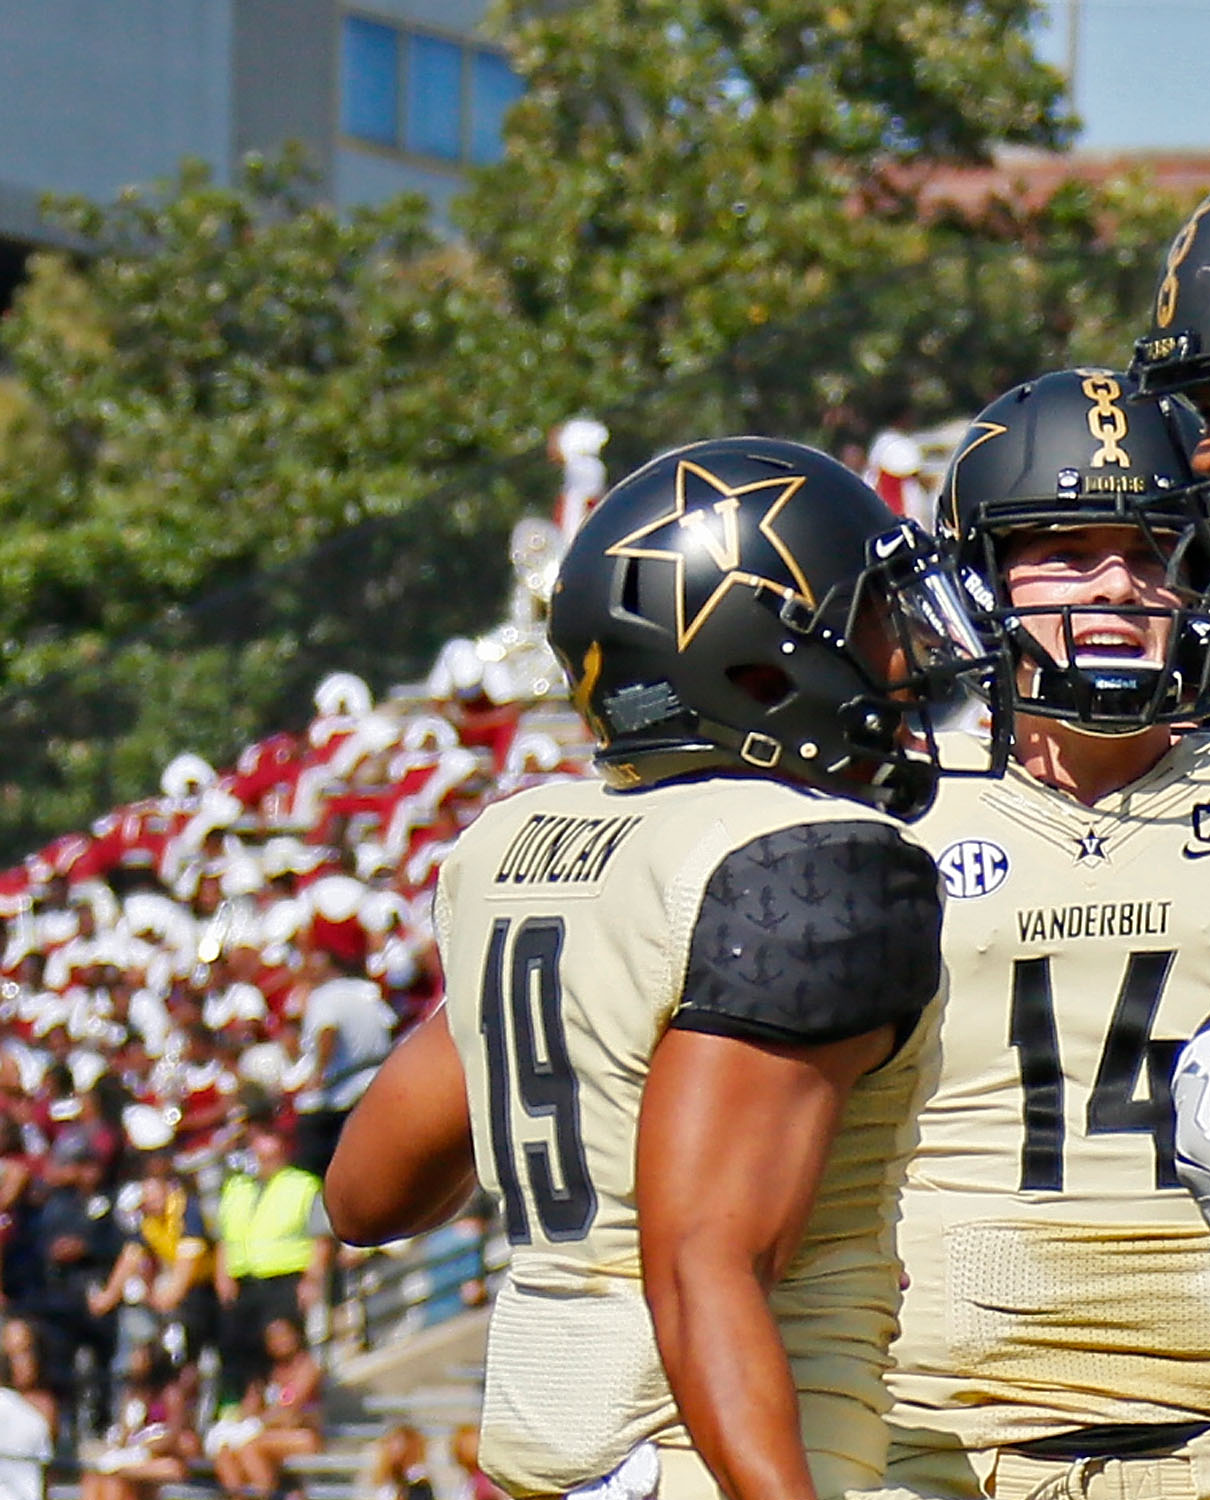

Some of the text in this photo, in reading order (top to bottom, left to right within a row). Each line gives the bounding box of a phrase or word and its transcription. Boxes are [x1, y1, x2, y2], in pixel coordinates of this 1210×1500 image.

[678, 497, 740, 572] V
[494, 813, 645, 884] DUNCAN
[940, 844, 1008, 896] SEC
[1017, 901, 1173, 943] VANDERBILT
[479, 916, 599, 1247] 19
[1009, 949, 1193, 1192] 14
